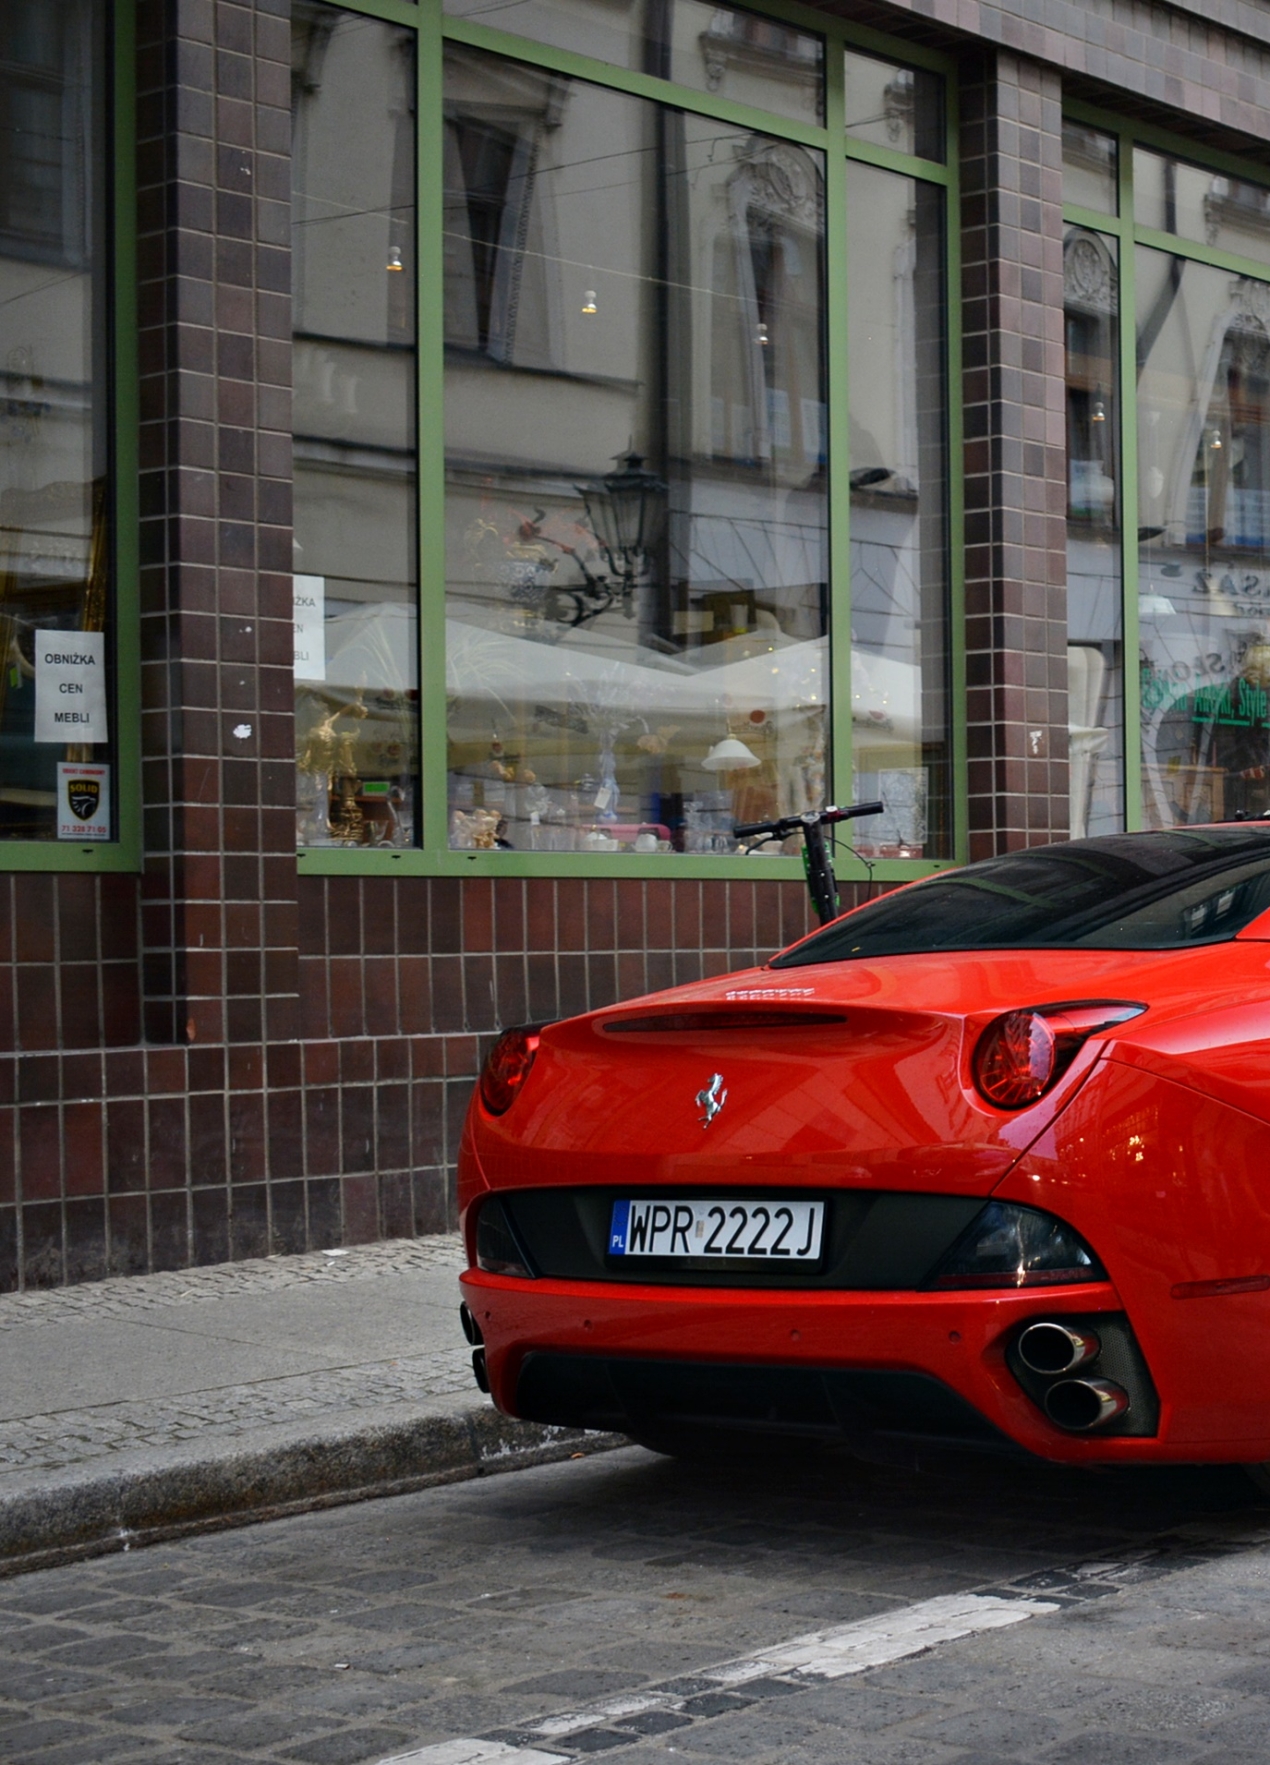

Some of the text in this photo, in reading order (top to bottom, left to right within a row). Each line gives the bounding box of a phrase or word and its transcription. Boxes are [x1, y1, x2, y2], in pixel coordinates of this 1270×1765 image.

[44, 652, 96, 666] OBNIŻKA
[294, 650, 309, 661] BLI
[59, 683, 84, 694] CEN
[1238, 677, 1267, 726] Style
[54, 712, 90, 723] MEBLI
[69, 783, 98, 794] SOLID
[611, 1204, 816, 1257] PL WPR 2222J
